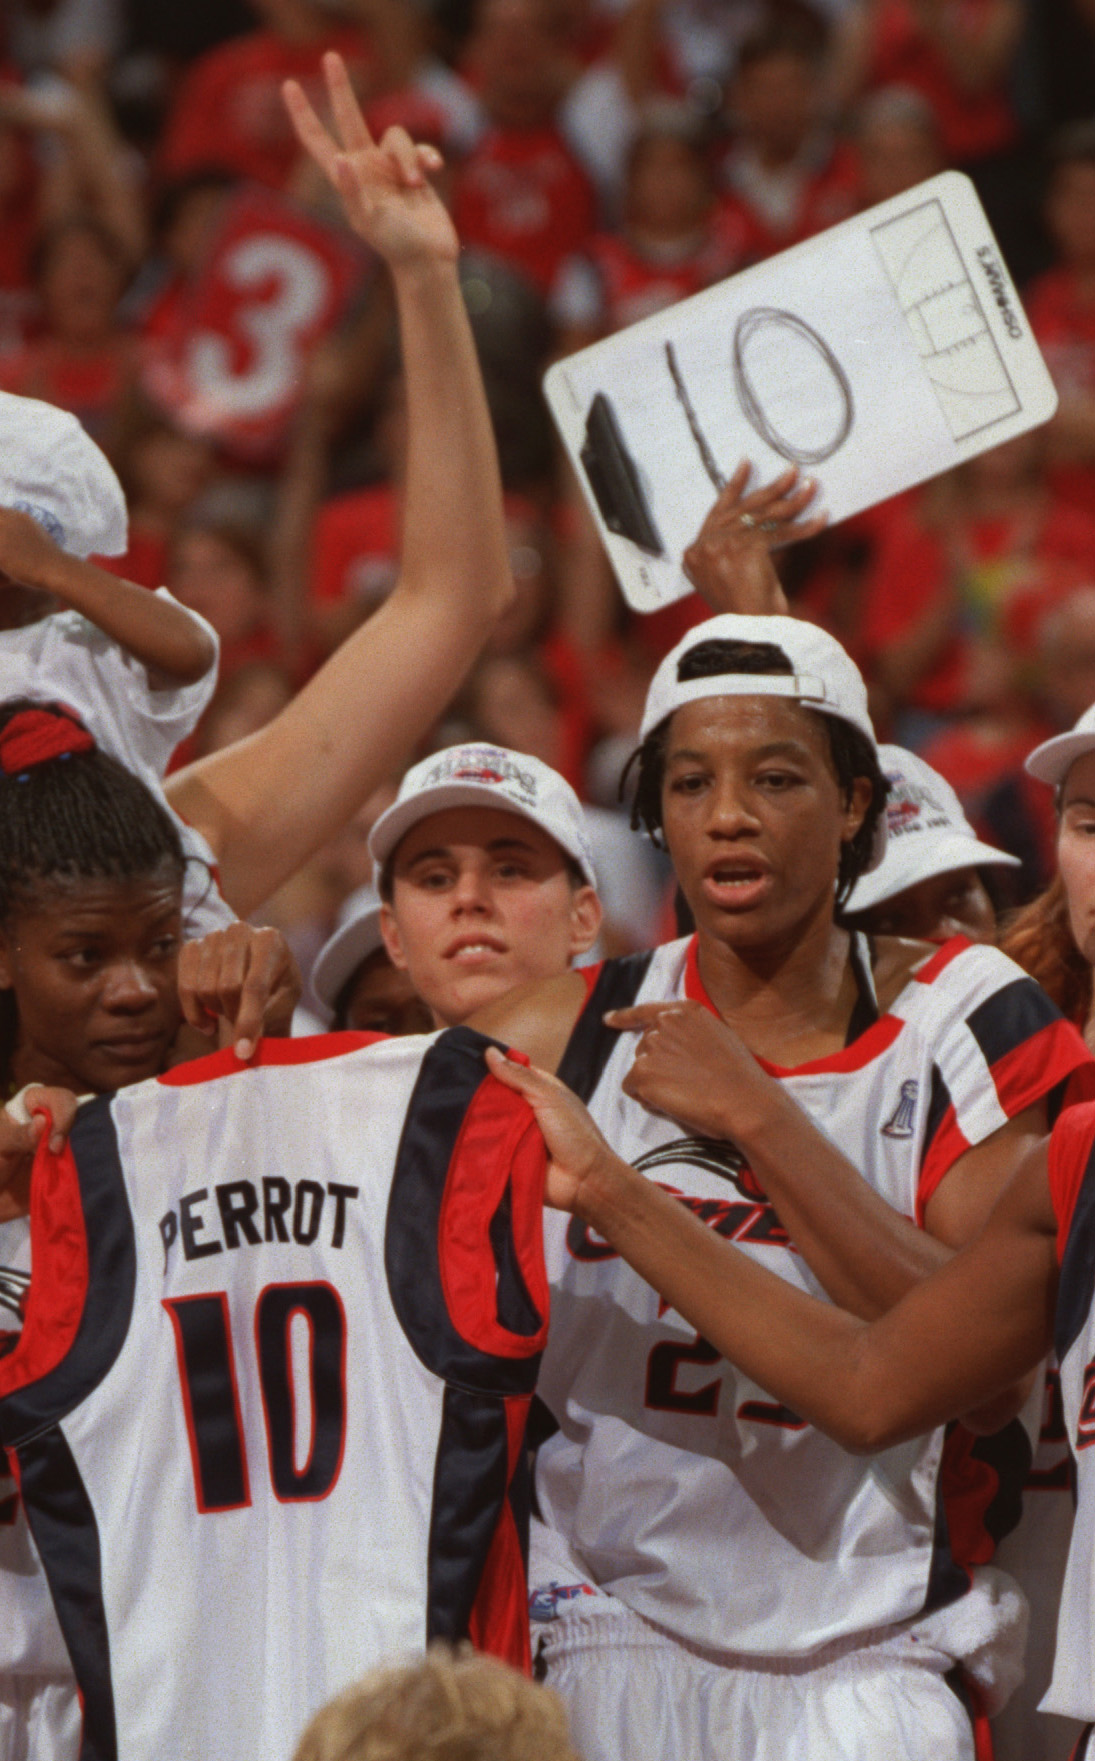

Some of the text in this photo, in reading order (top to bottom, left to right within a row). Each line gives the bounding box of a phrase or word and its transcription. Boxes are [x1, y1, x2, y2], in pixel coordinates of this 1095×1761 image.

[186, 232, 329, 412] 3
[663, 306, 856, 498] 10
[158, 1176, 359, 1277] PERROT
[160, 1279, 348, 1514] 10
